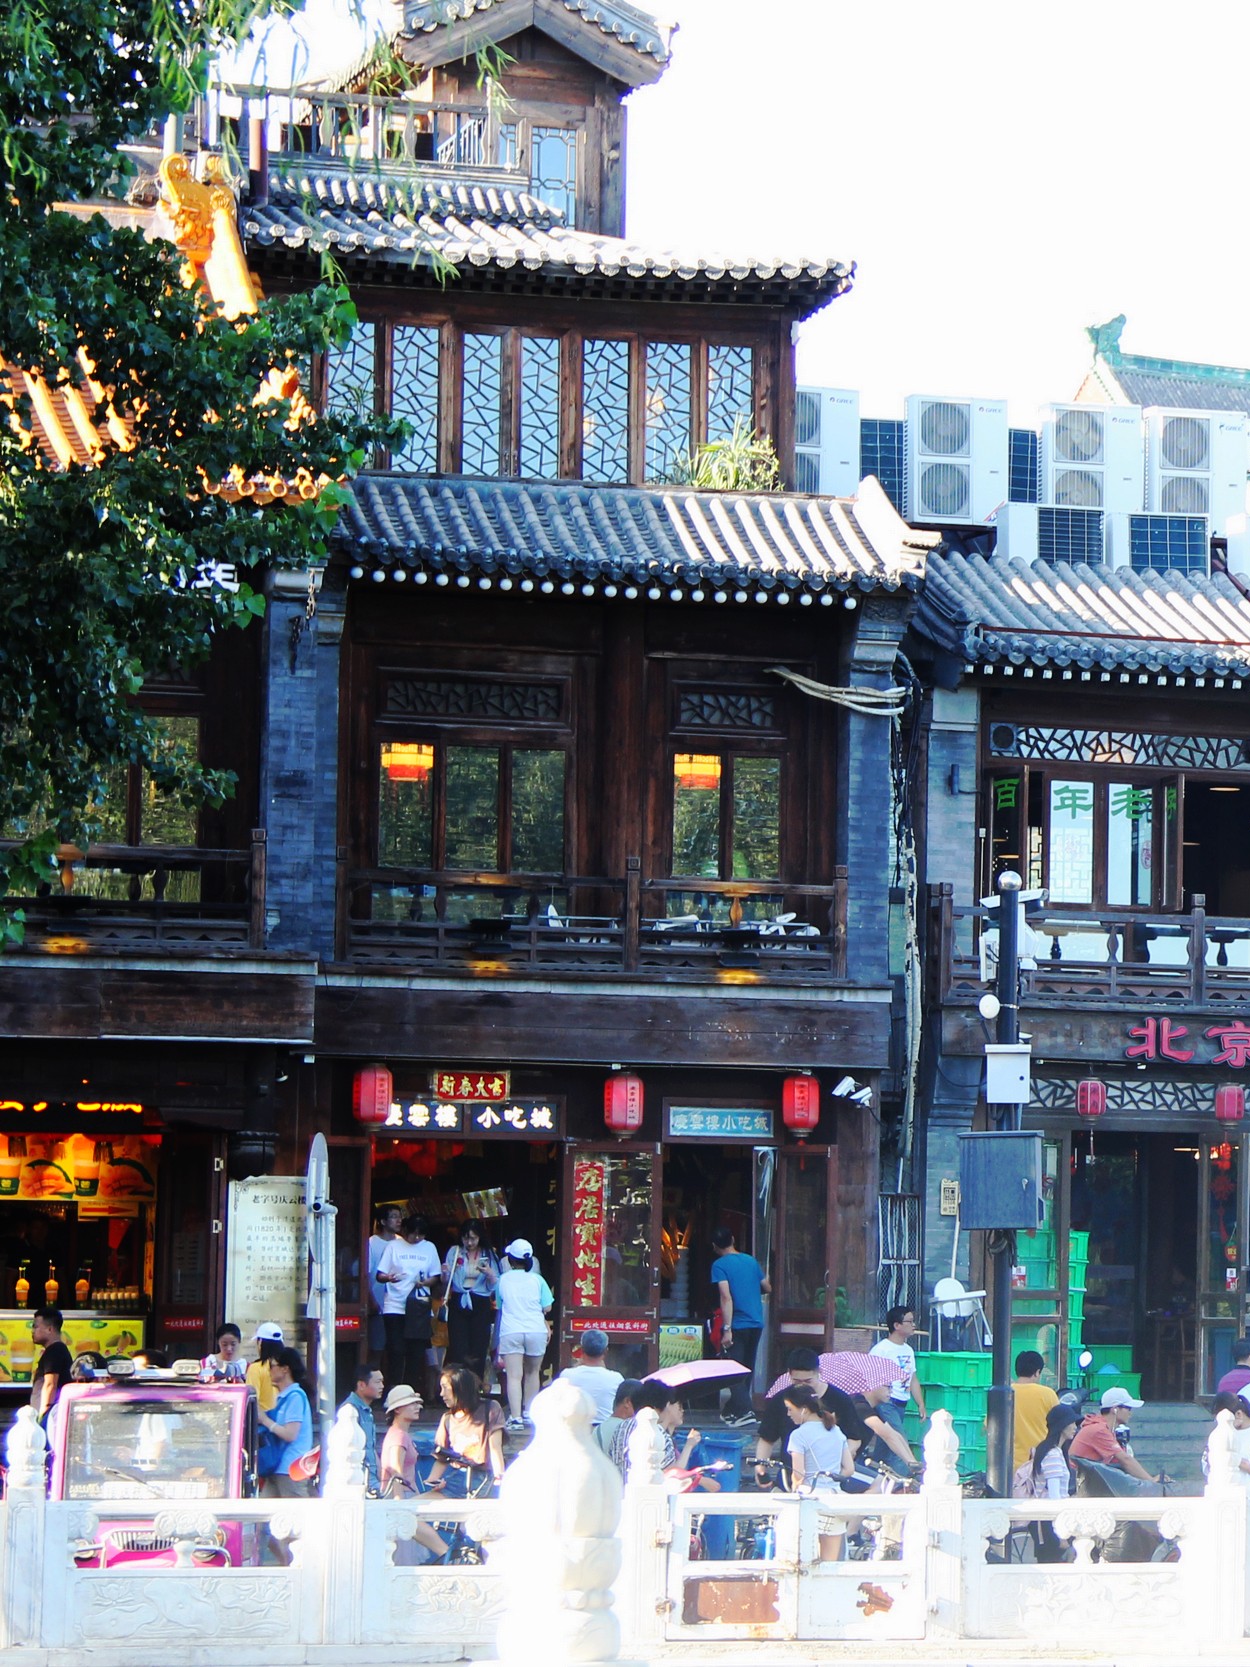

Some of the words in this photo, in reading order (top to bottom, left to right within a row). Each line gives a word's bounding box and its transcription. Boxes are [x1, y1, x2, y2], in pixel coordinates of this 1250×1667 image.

[440, 1075, 504, 1097] 新春大吉
[477, 1105, 554, 1130] 小吃城
